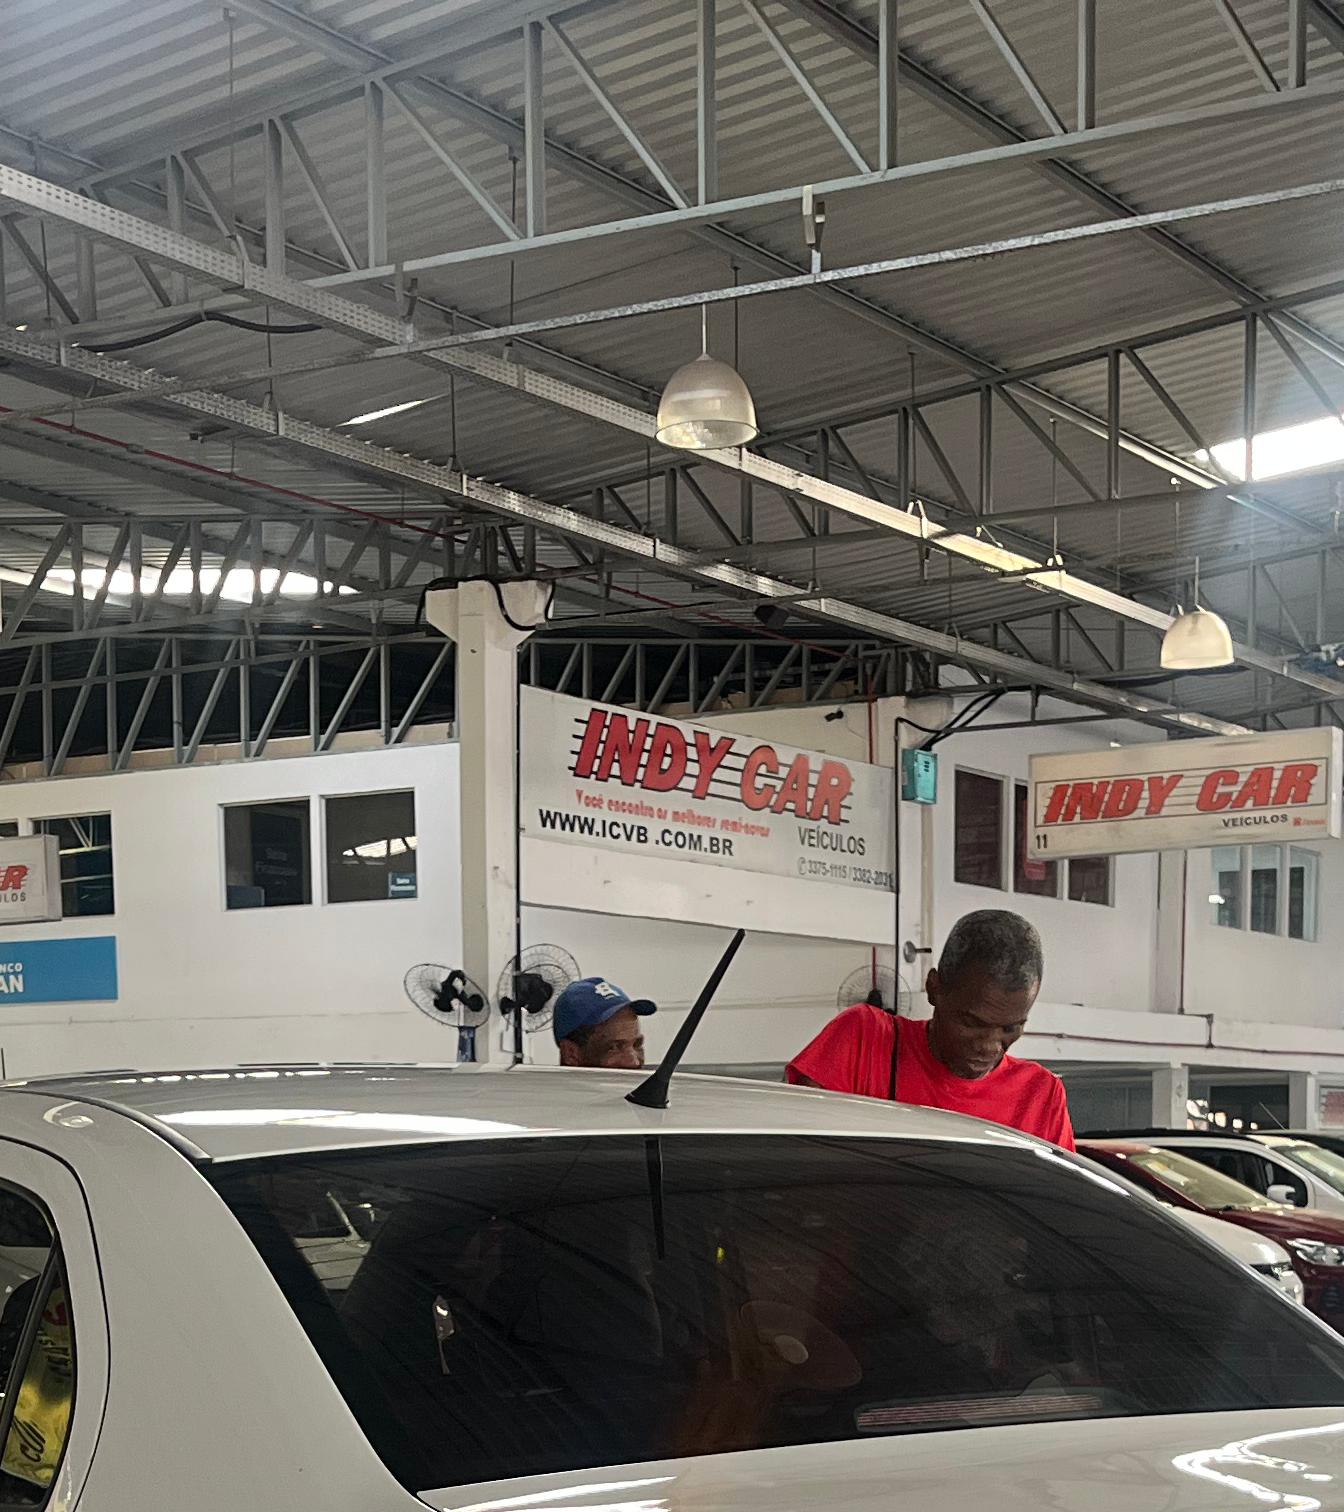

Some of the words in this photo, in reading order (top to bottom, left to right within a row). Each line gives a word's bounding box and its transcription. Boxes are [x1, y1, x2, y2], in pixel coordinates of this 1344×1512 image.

[572, 707, 736, 800] INDY
[740, 744, 853, 826] CAR
[1043, 774, 1184, 824] INDY
[1196, 763, 1319, 812] CAR
[1221, 813, 1289, 828] VEÍCULOS
[798, 825, 865, 856] VEÍCULOS
[1035, 834, 1049, 850] 11
